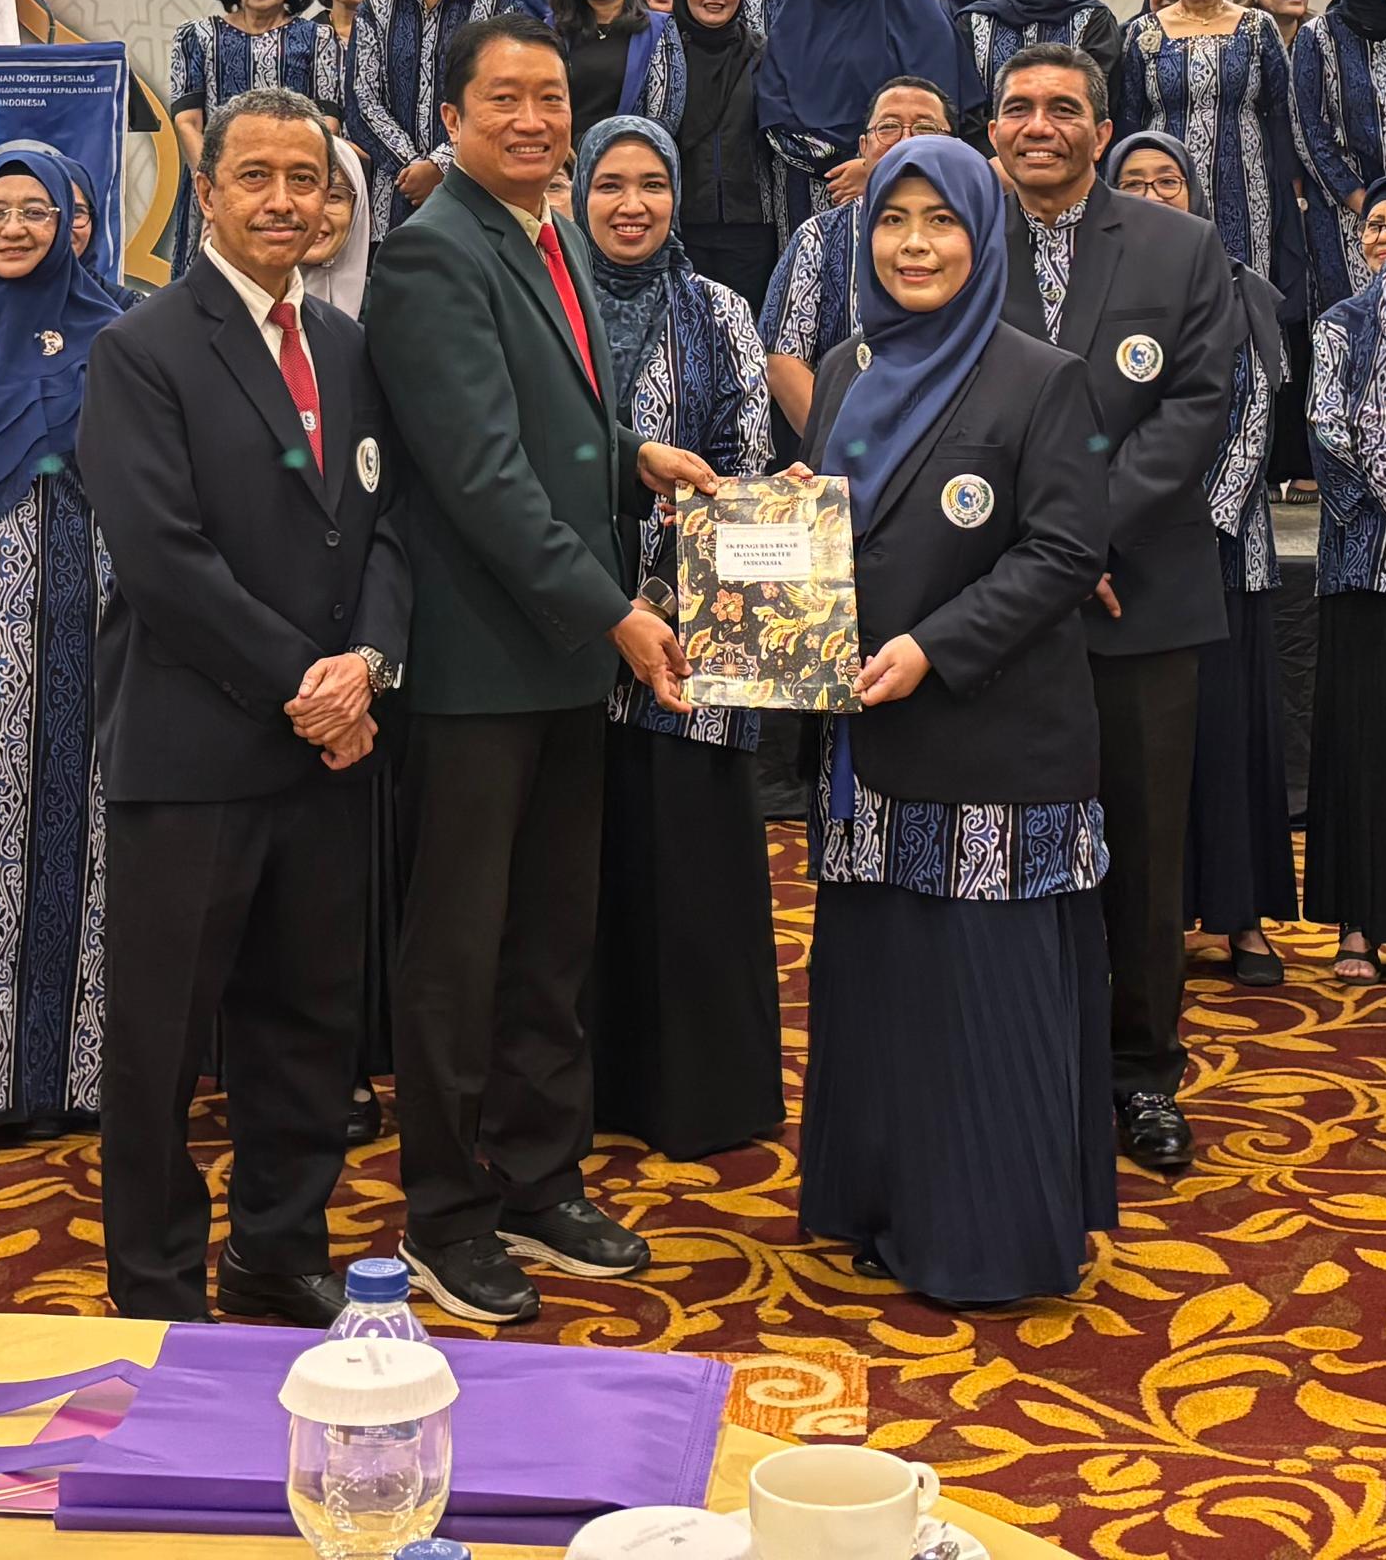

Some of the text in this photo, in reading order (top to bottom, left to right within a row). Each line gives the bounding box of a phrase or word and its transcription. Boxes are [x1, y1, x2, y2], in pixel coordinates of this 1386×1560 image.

[16, 74, 52, 83] DOKTER
[53, 73, 95, 83] SPESIALIS
[0, 98, 47, 108] INDONESIA
